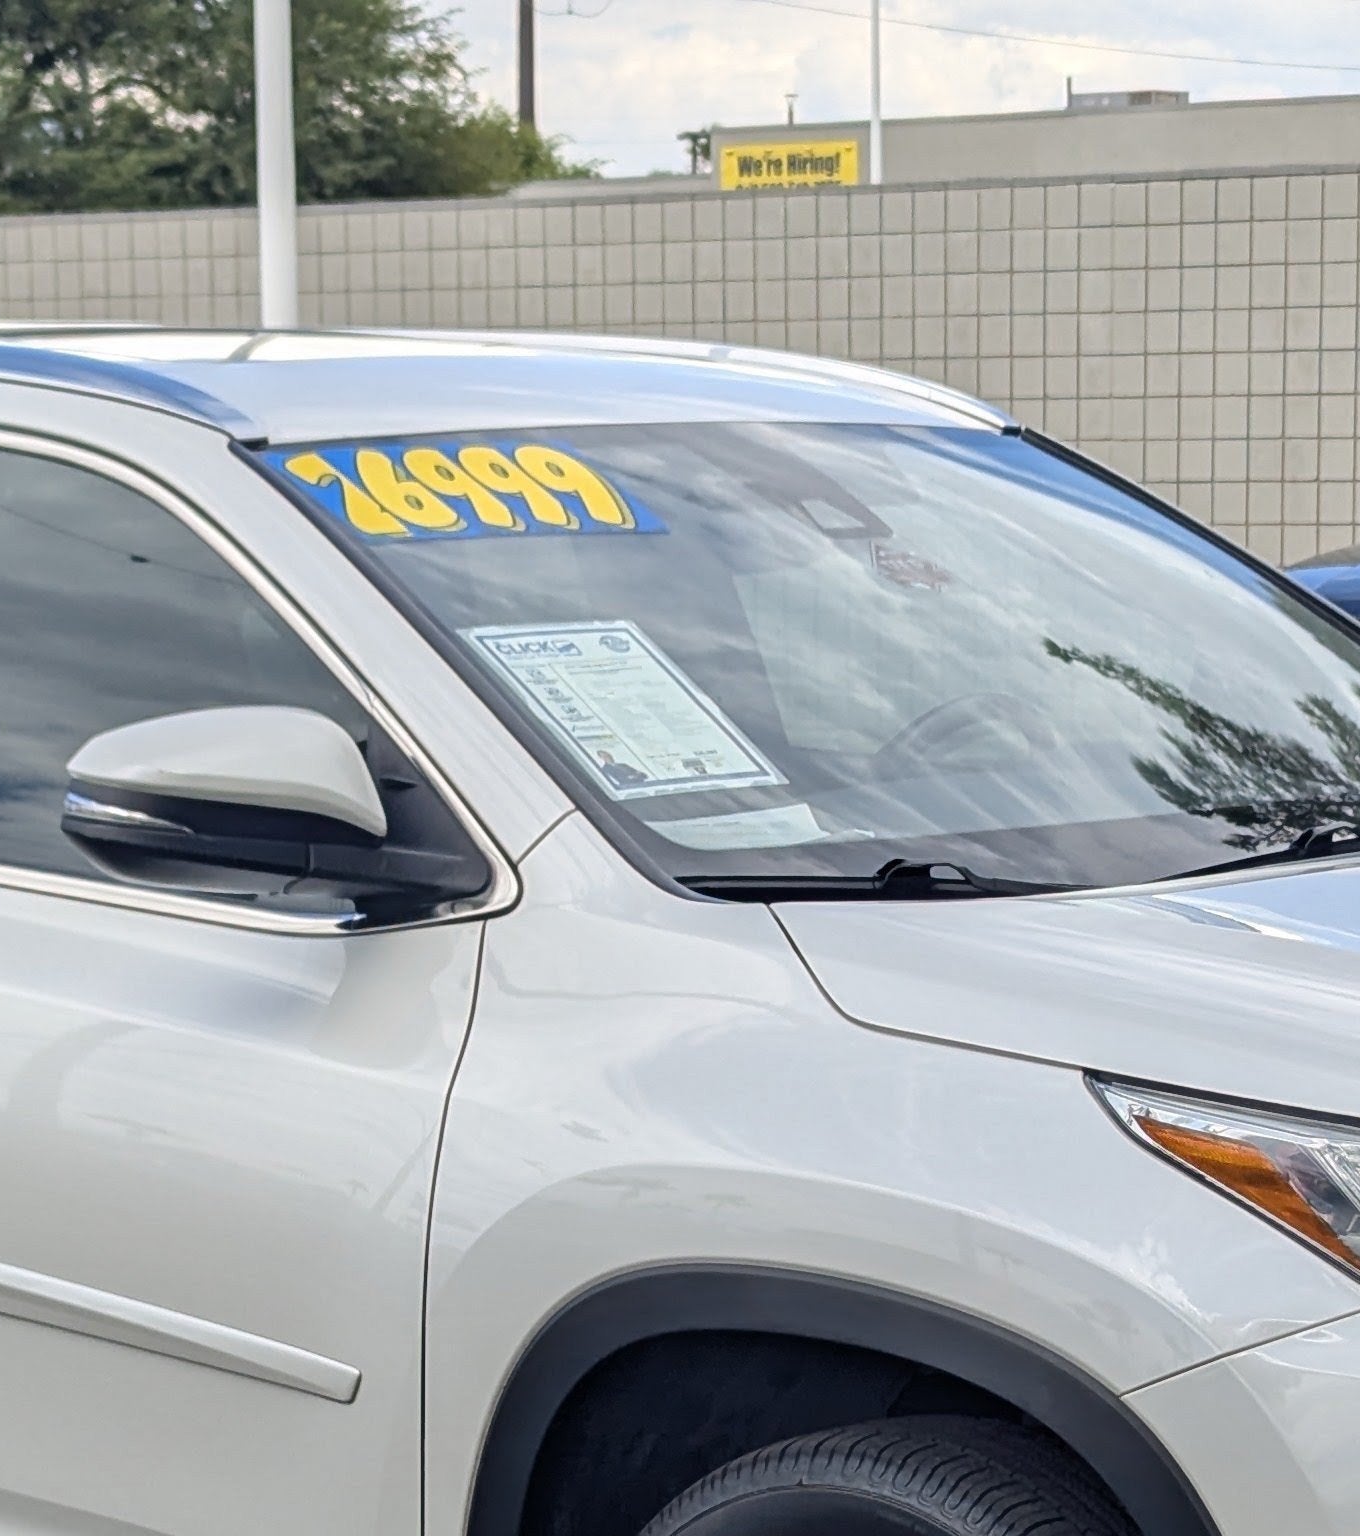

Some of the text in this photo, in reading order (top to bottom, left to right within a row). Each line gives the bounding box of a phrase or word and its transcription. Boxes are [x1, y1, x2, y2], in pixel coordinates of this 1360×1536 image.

[737, 152, 841, 177] We're Hiring!
[285, 445, 637, 536] 26999
